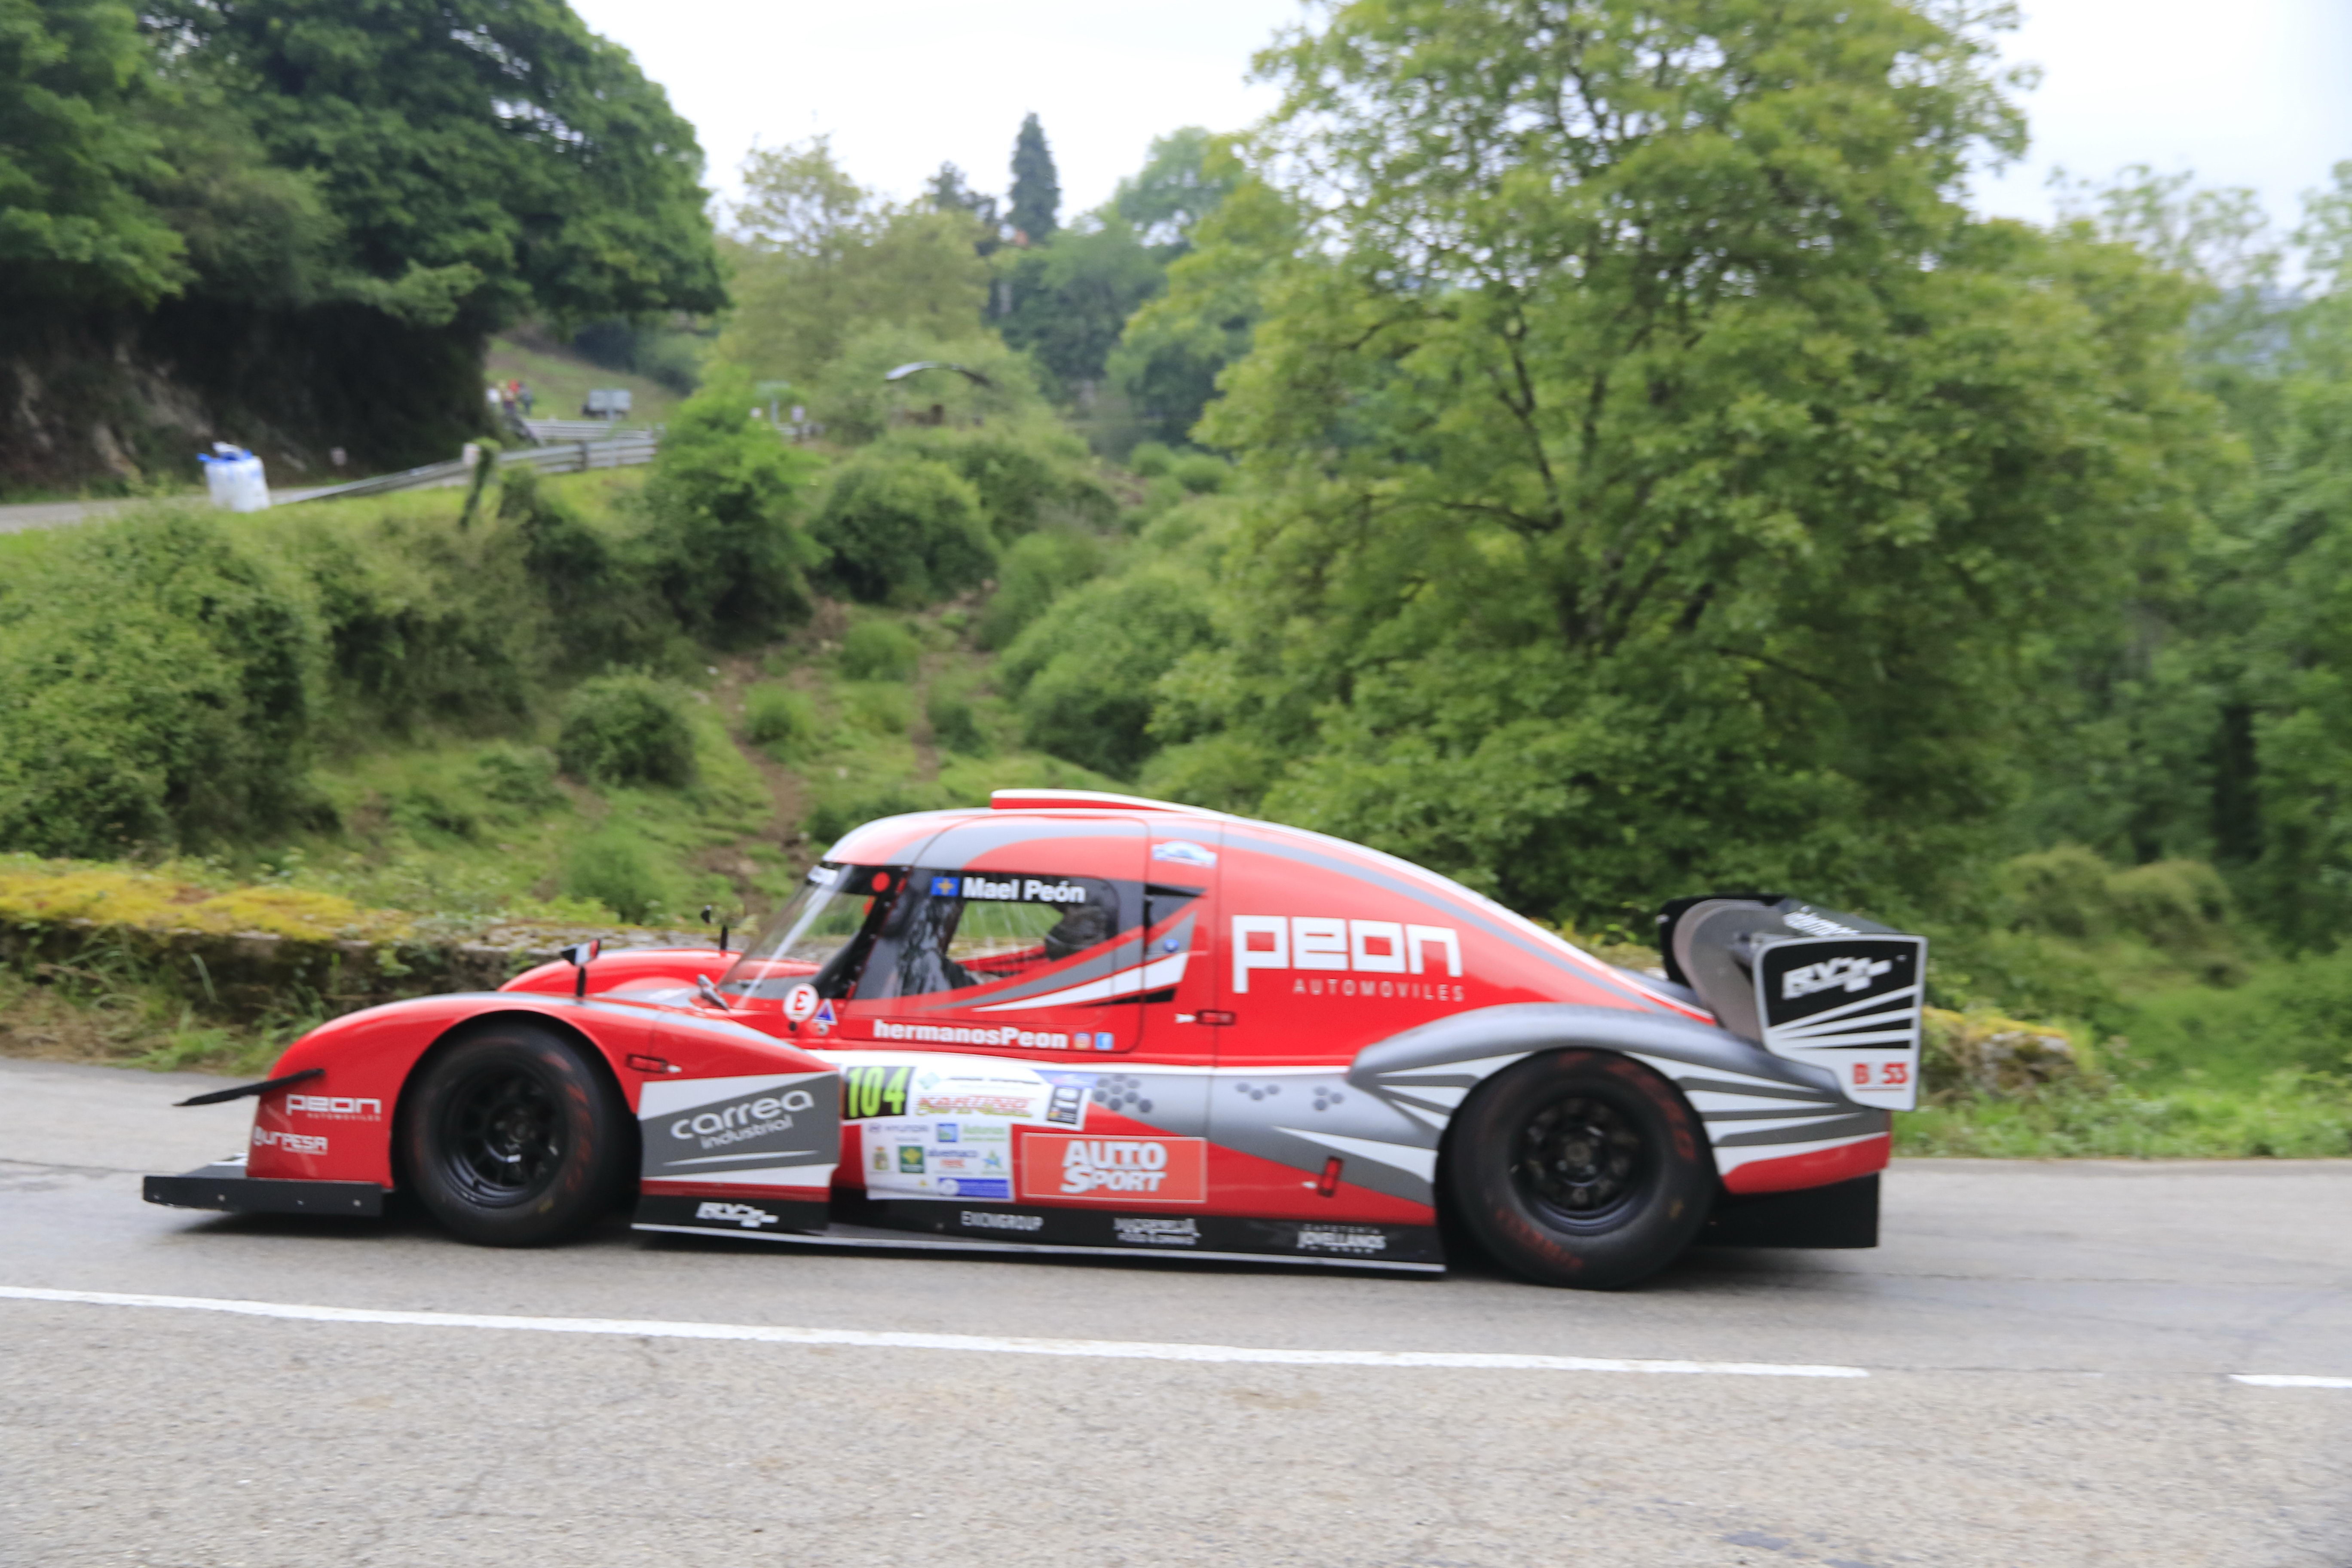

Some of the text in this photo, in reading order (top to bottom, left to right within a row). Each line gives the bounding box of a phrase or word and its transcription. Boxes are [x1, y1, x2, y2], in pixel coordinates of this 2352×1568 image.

[962, 877, 1086, 903] Mael Peón
[1293, 978, 1464, 1001] AUTOMOVILES
[873, 1019, 1069, 1049] hermanosPeon
[1881, 1062, 1908, 1084] 53
[848, 1066, 911, 1119] 104
[671, 1090, 815, 1139] carrea
[699, 1113, 795, 1151] industrial
[1062, 1139, 1168, 1171] AUTO
